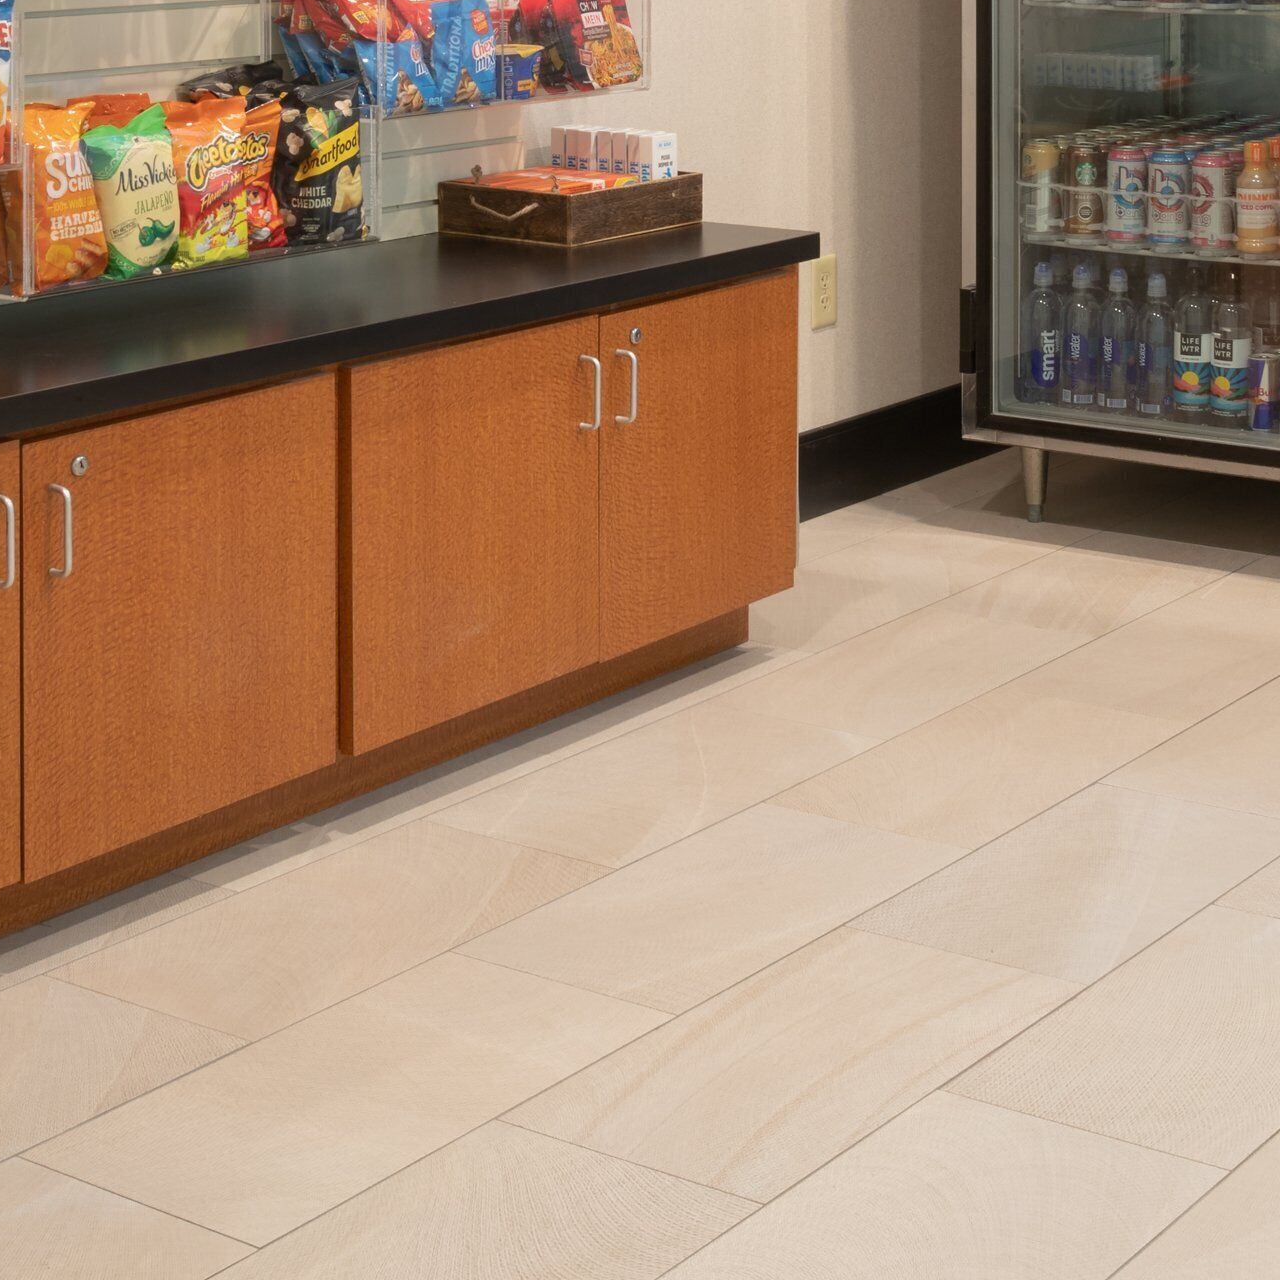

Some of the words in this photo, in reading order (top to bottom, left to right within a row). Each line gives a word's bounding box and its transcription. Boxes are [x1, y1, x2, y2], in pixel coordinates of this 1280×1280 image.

[584, 14, 602, 25] MEIN
[472, 34, 496, 61] Chex
[476, 56, 497, 74] mix
[302, 134, 358, 174] Smartfood
[299, 186, 326, 198] WHITE
[291, 196, 332, 208] CHEDDAR
[50, 220, 104, 241] CHEDDA
[1181, 336, 1200, 346] LIFE
[1214, 340, 1232, 350] LIFE
[1181, 344, 1200, 354] WTR
[1214, 348, 1232, 360] WTR
[1042, 330, 1056, 381] smart
